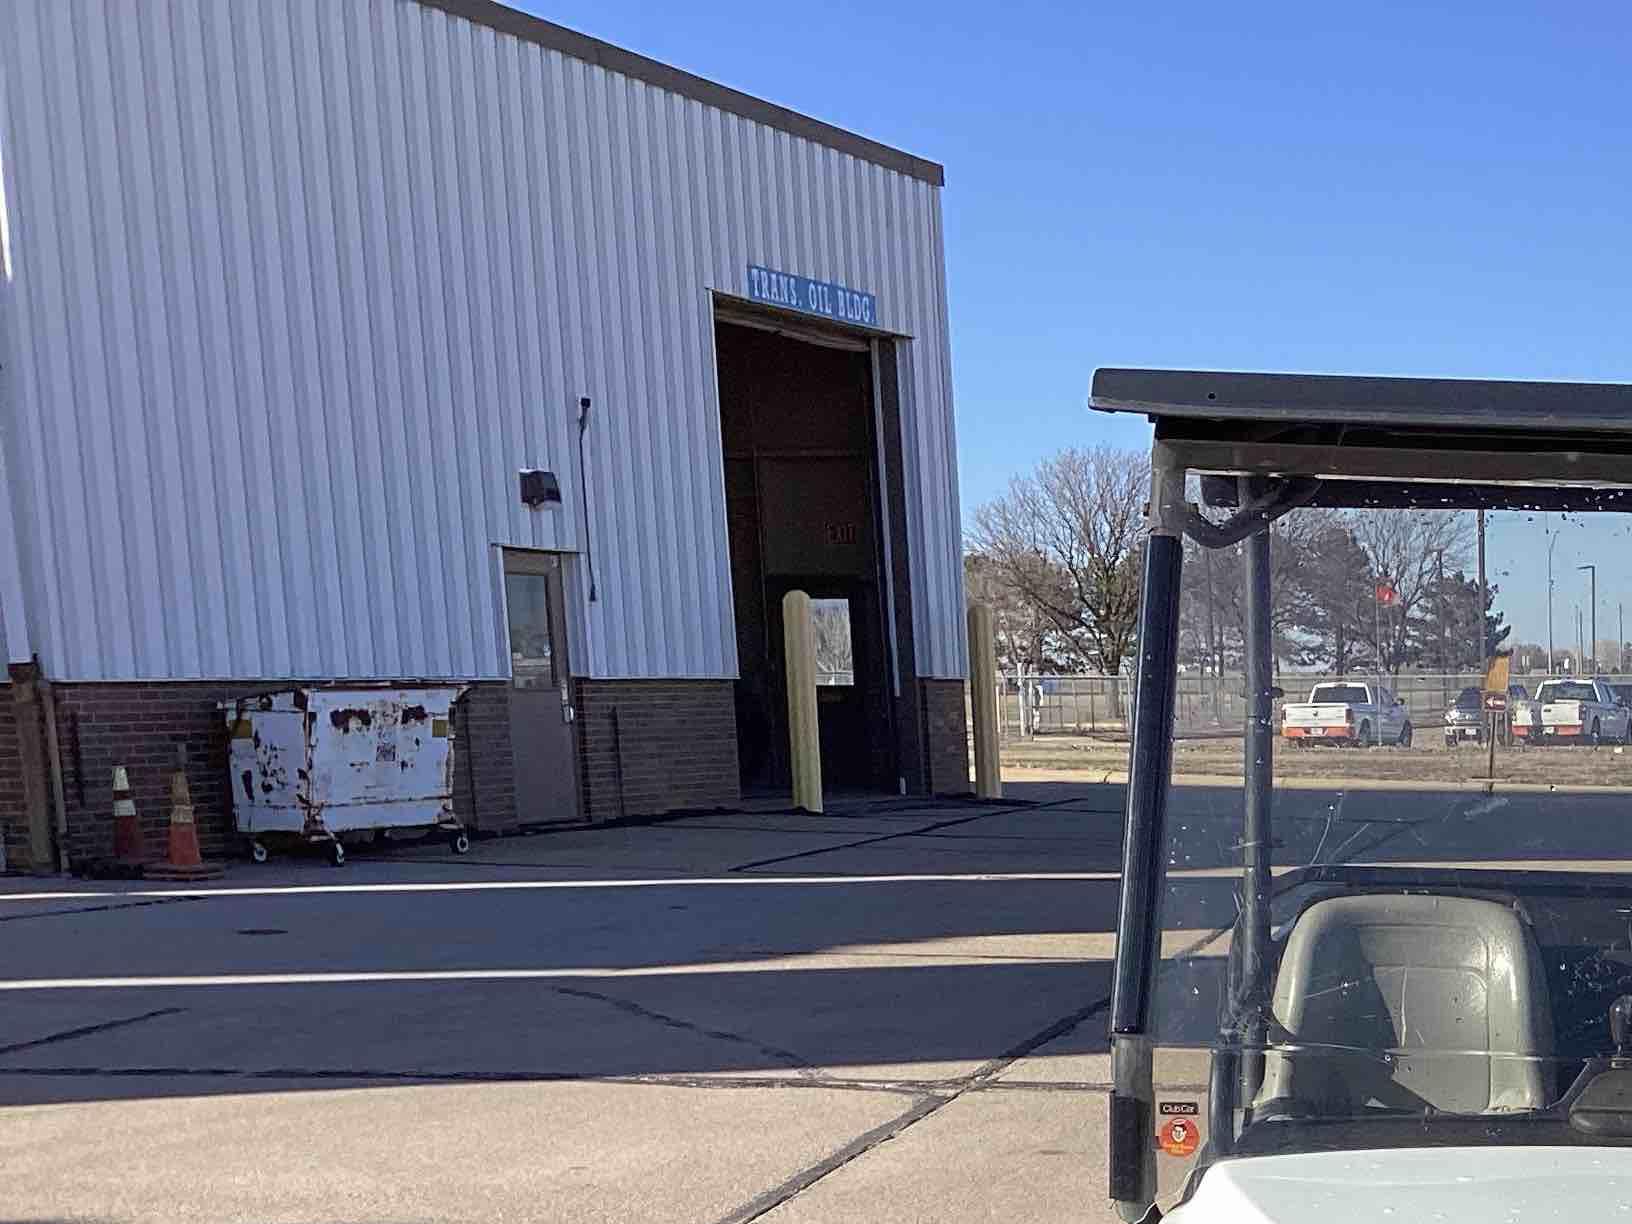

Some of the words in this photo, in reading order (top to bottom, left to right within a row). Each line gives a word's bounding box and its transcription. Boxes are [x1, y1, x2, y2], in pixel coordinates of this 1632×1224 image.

[751, 269, 802, 306] TRANS.
[808, 282, 832, 313] OIL
[838, 289, 876, 323] BLDG.
